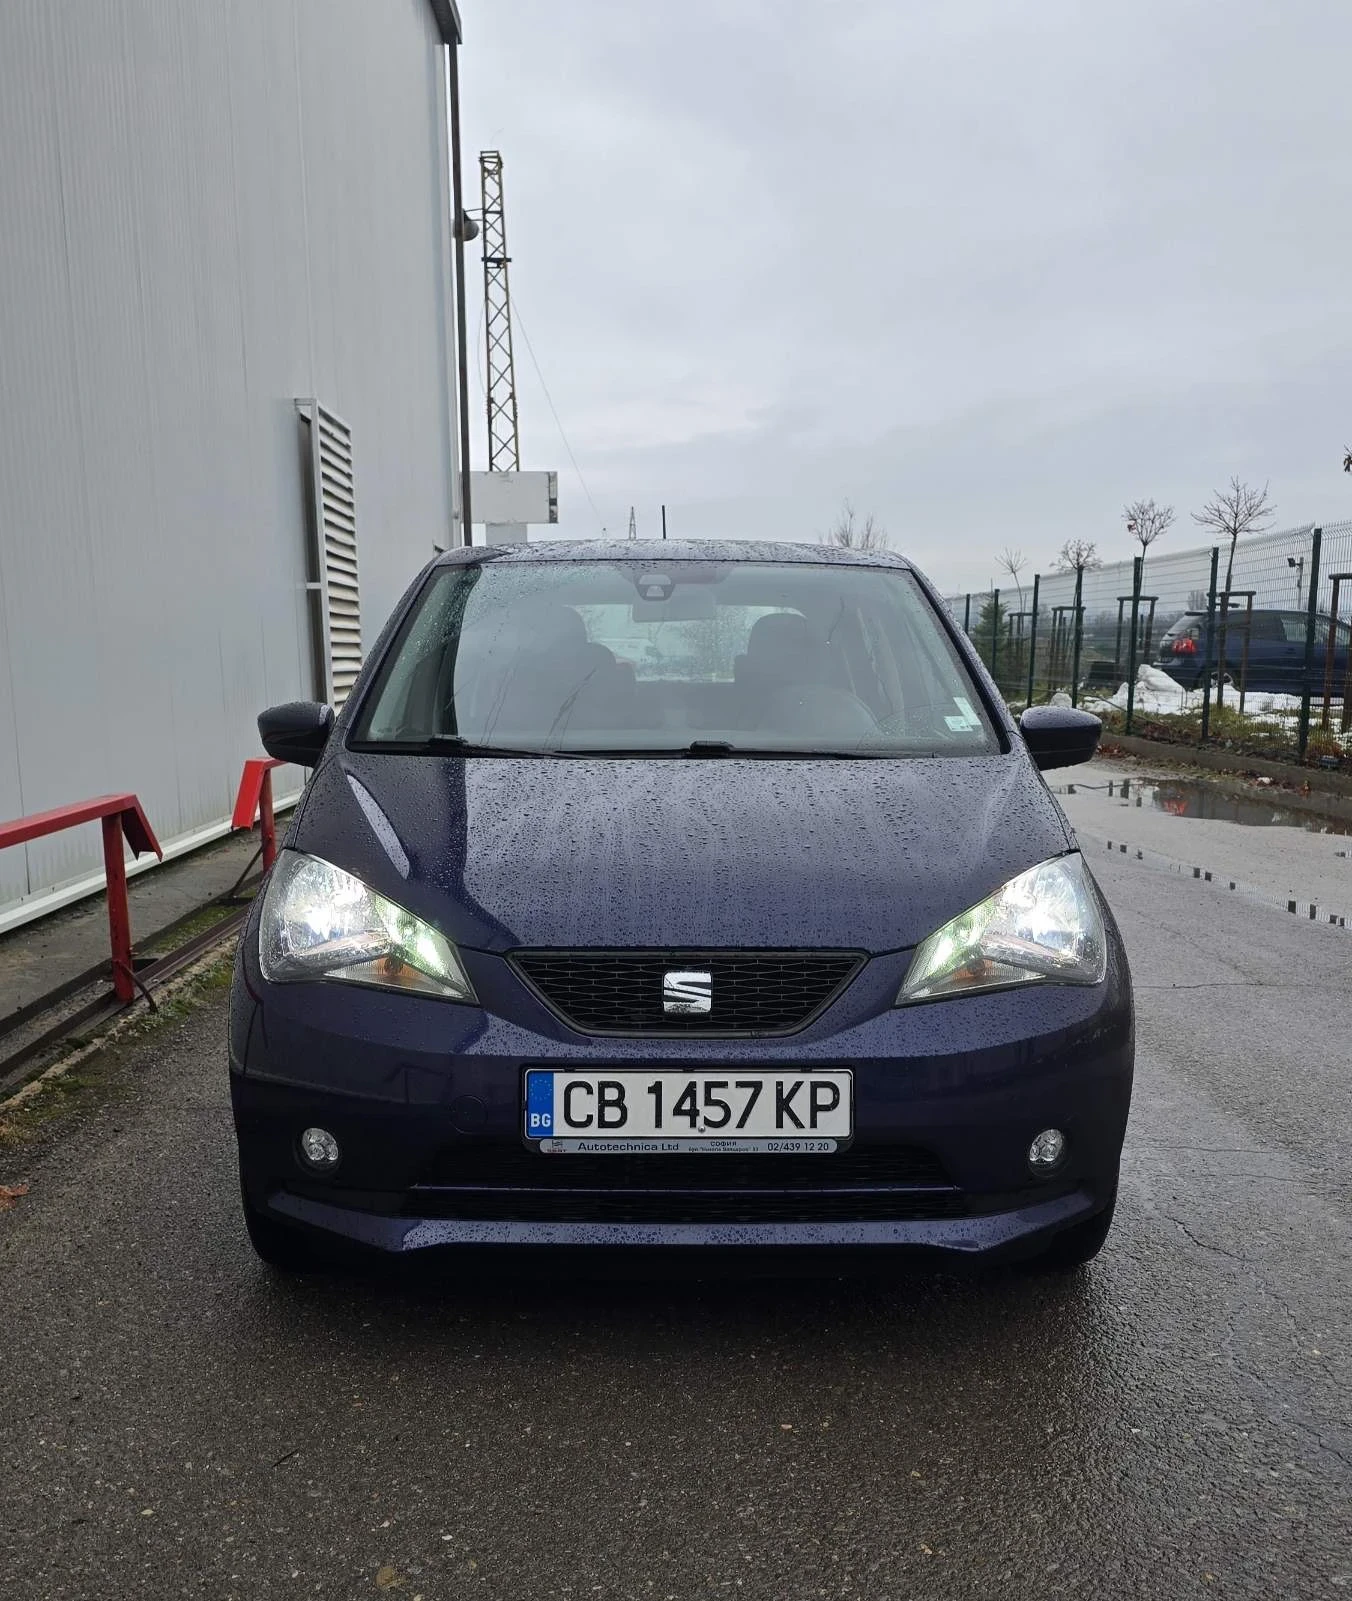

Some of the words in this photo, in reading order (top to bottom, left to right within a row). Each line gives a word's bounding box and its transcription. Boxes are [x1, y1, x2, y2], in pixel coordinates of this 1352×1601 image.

[563, 1080, 628, 1129] CB
[646, 1080, 763, 1129] 1457
[775, 1080, 841, 1129] KP
[530, 1113, 552, 1128] BG
[577, 1142, 658, 1151] Autotechnica
[661, 1142, 679, 1151] Ltd
[767, 1142, 801, 1152] 02/439
[804, 1142, 816, 1152] 12
[818, 1142, 829, 1152] 20
